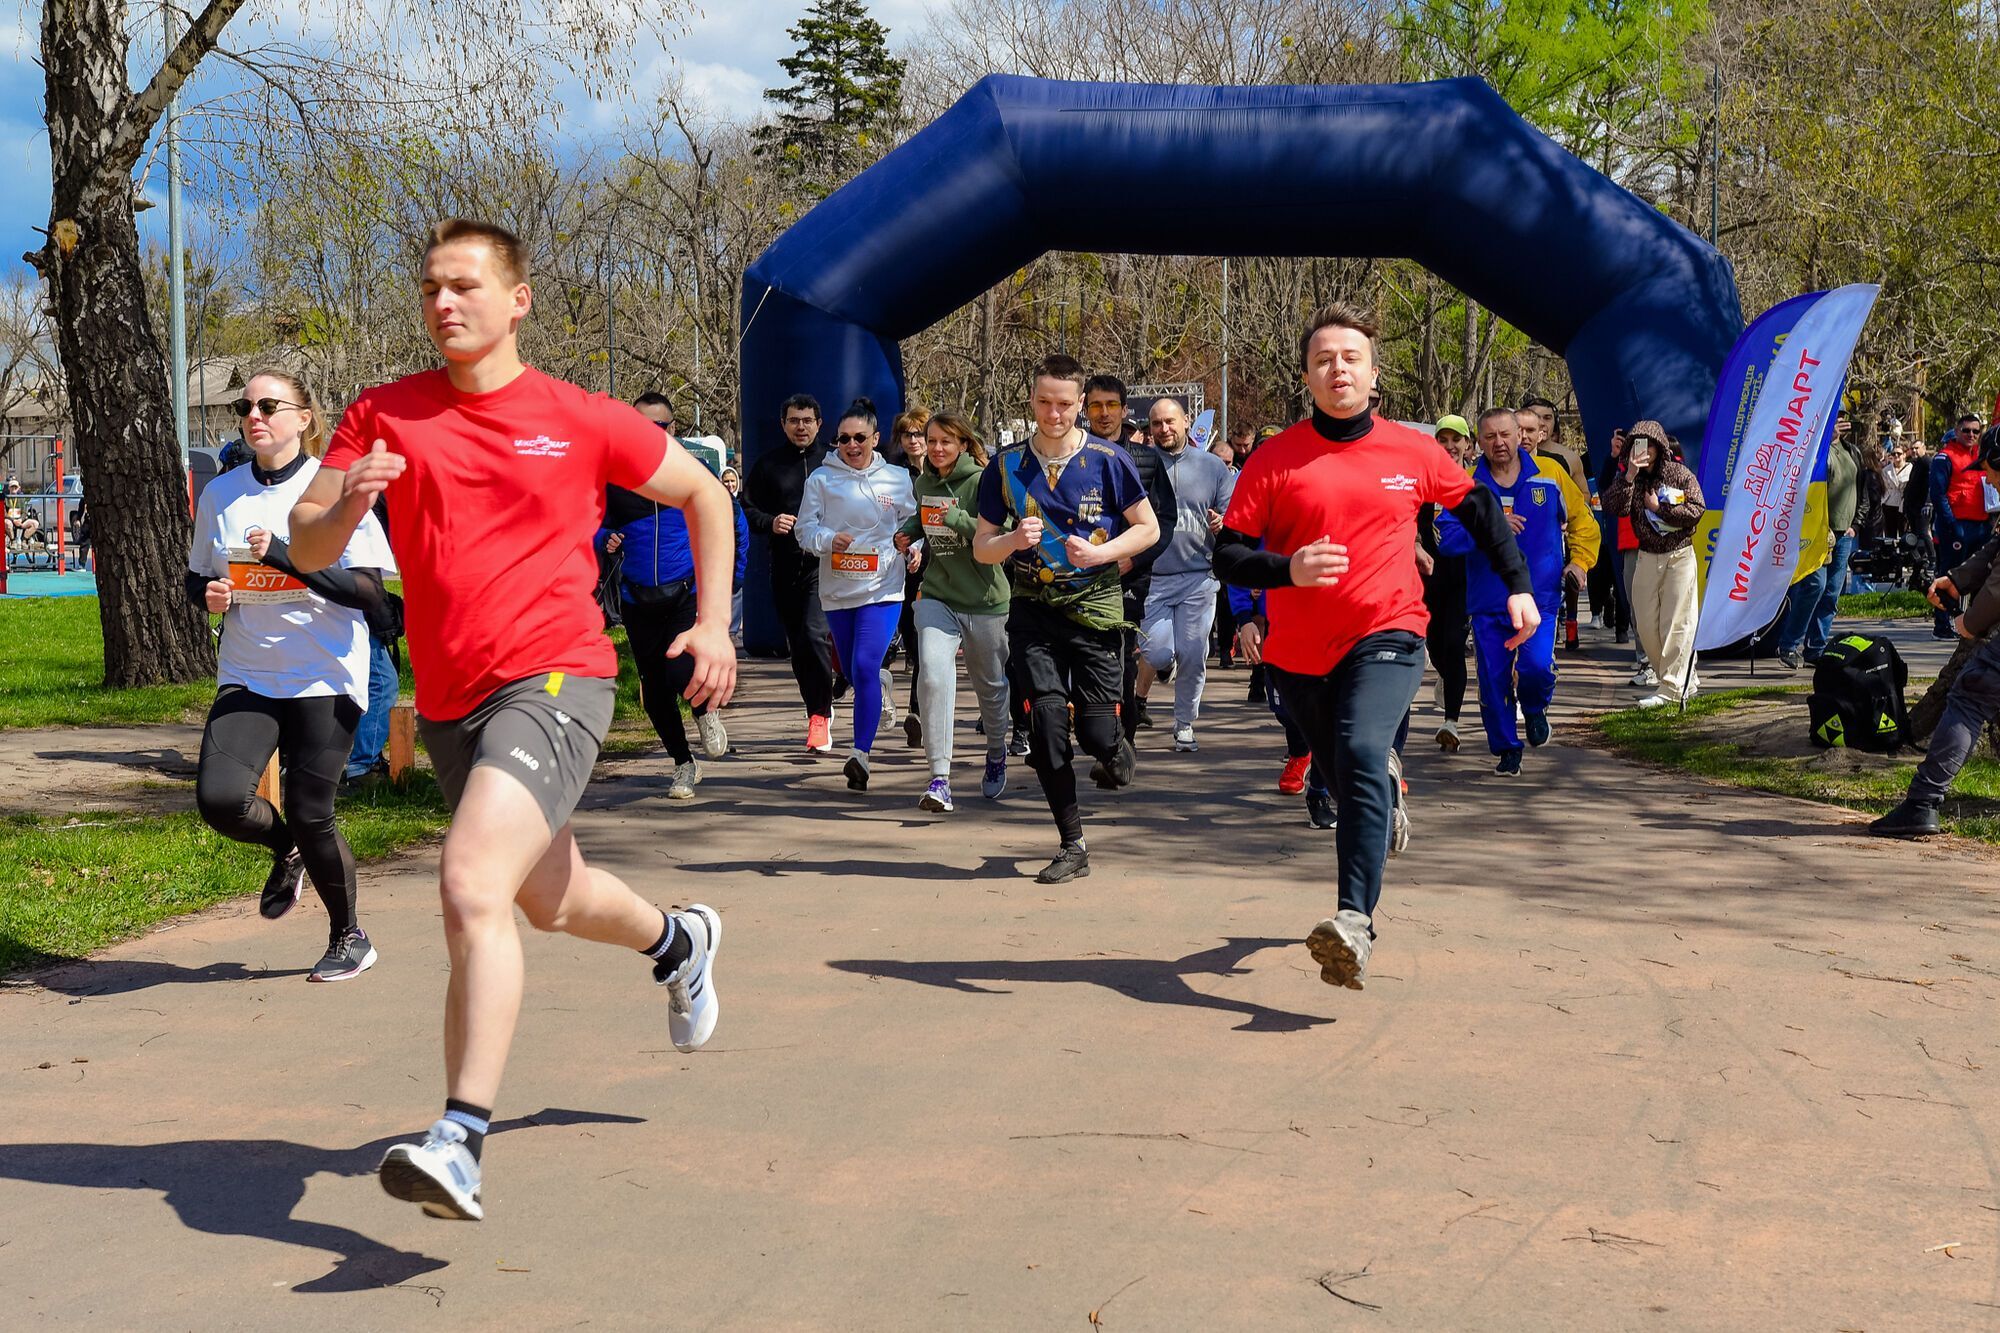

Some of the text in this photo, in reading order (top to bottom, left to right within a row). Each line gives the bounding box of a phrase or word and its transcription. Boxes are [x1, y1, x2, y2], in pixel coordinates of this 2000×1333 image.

[1728, 510, 1767, 602] МІКС
[1776, 348, 1821, 445] МАРТ
[1772, 464, 1801, 567] необхідне
[840, 559, 869, 571] 2036
[245, 572, 288, 588] 2077
[509, 746, 540, 771] JAKO
